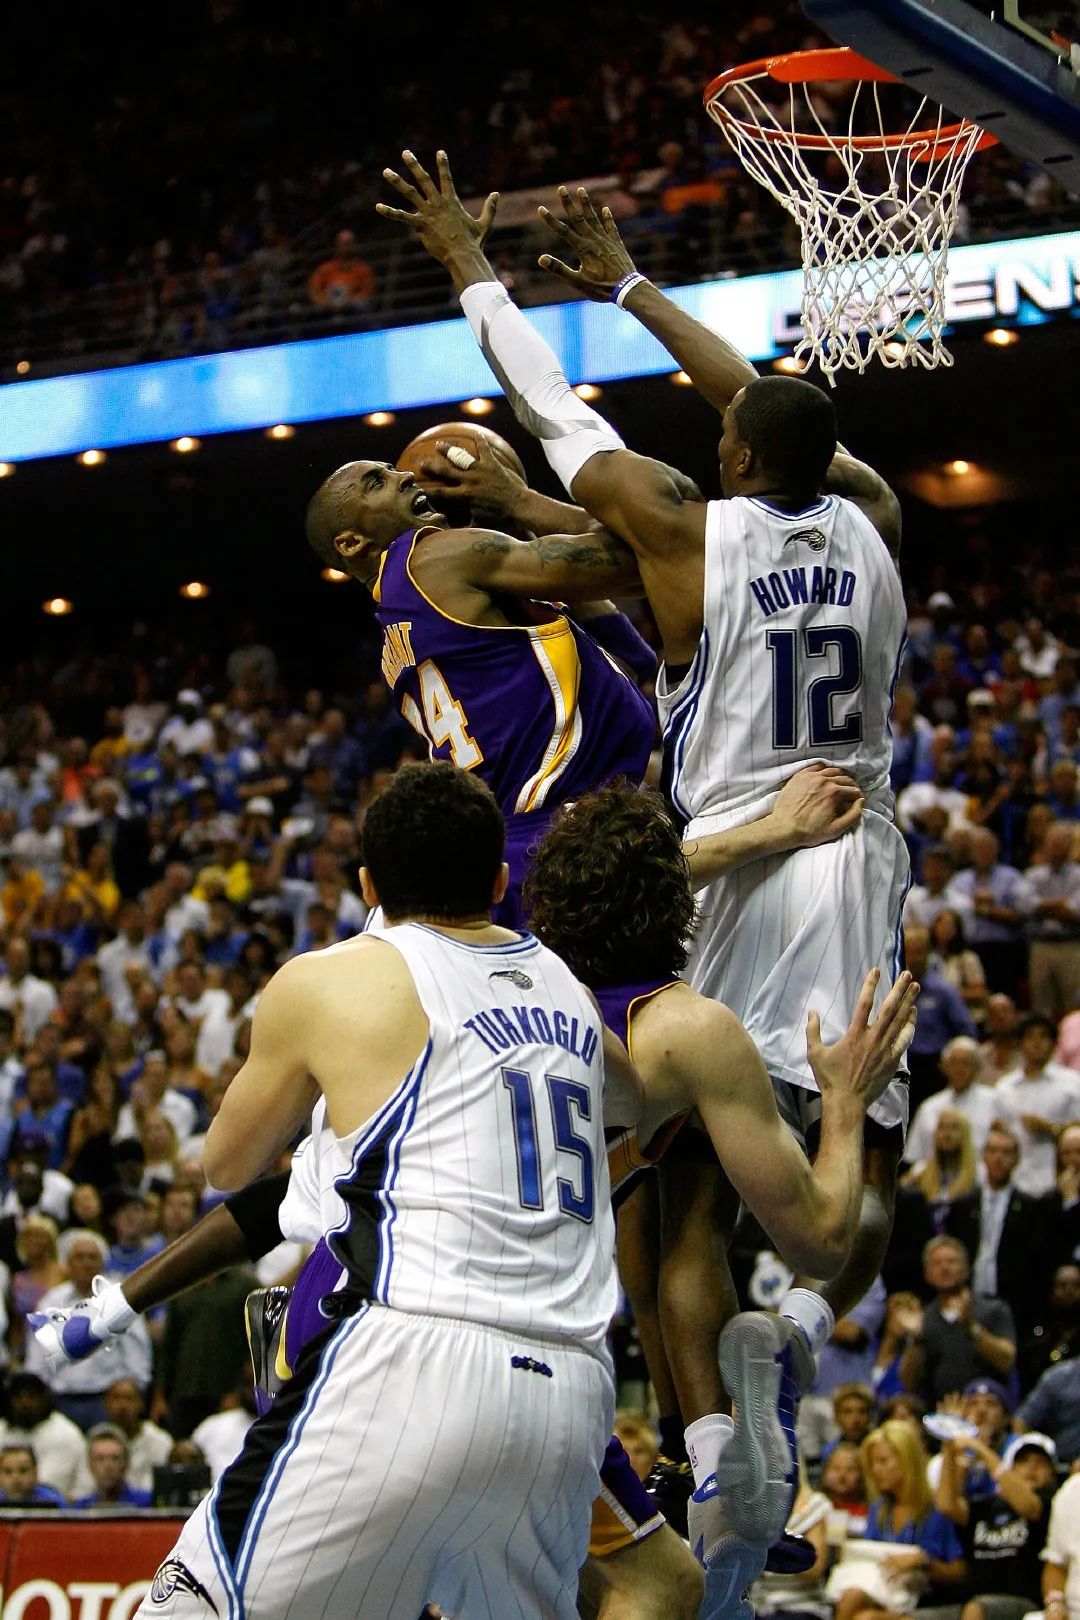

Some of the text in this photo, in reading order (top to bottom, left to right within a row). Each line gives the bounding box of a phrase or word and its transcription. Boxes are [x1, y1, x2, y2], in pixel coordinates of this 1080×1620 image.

[750, 565, 857, 617] HOWARD
[765, 624, 863, 750] 12
[463, 1006, 598, 1067] TURKOGLU
[500, 1066, 594, 1224] 15
